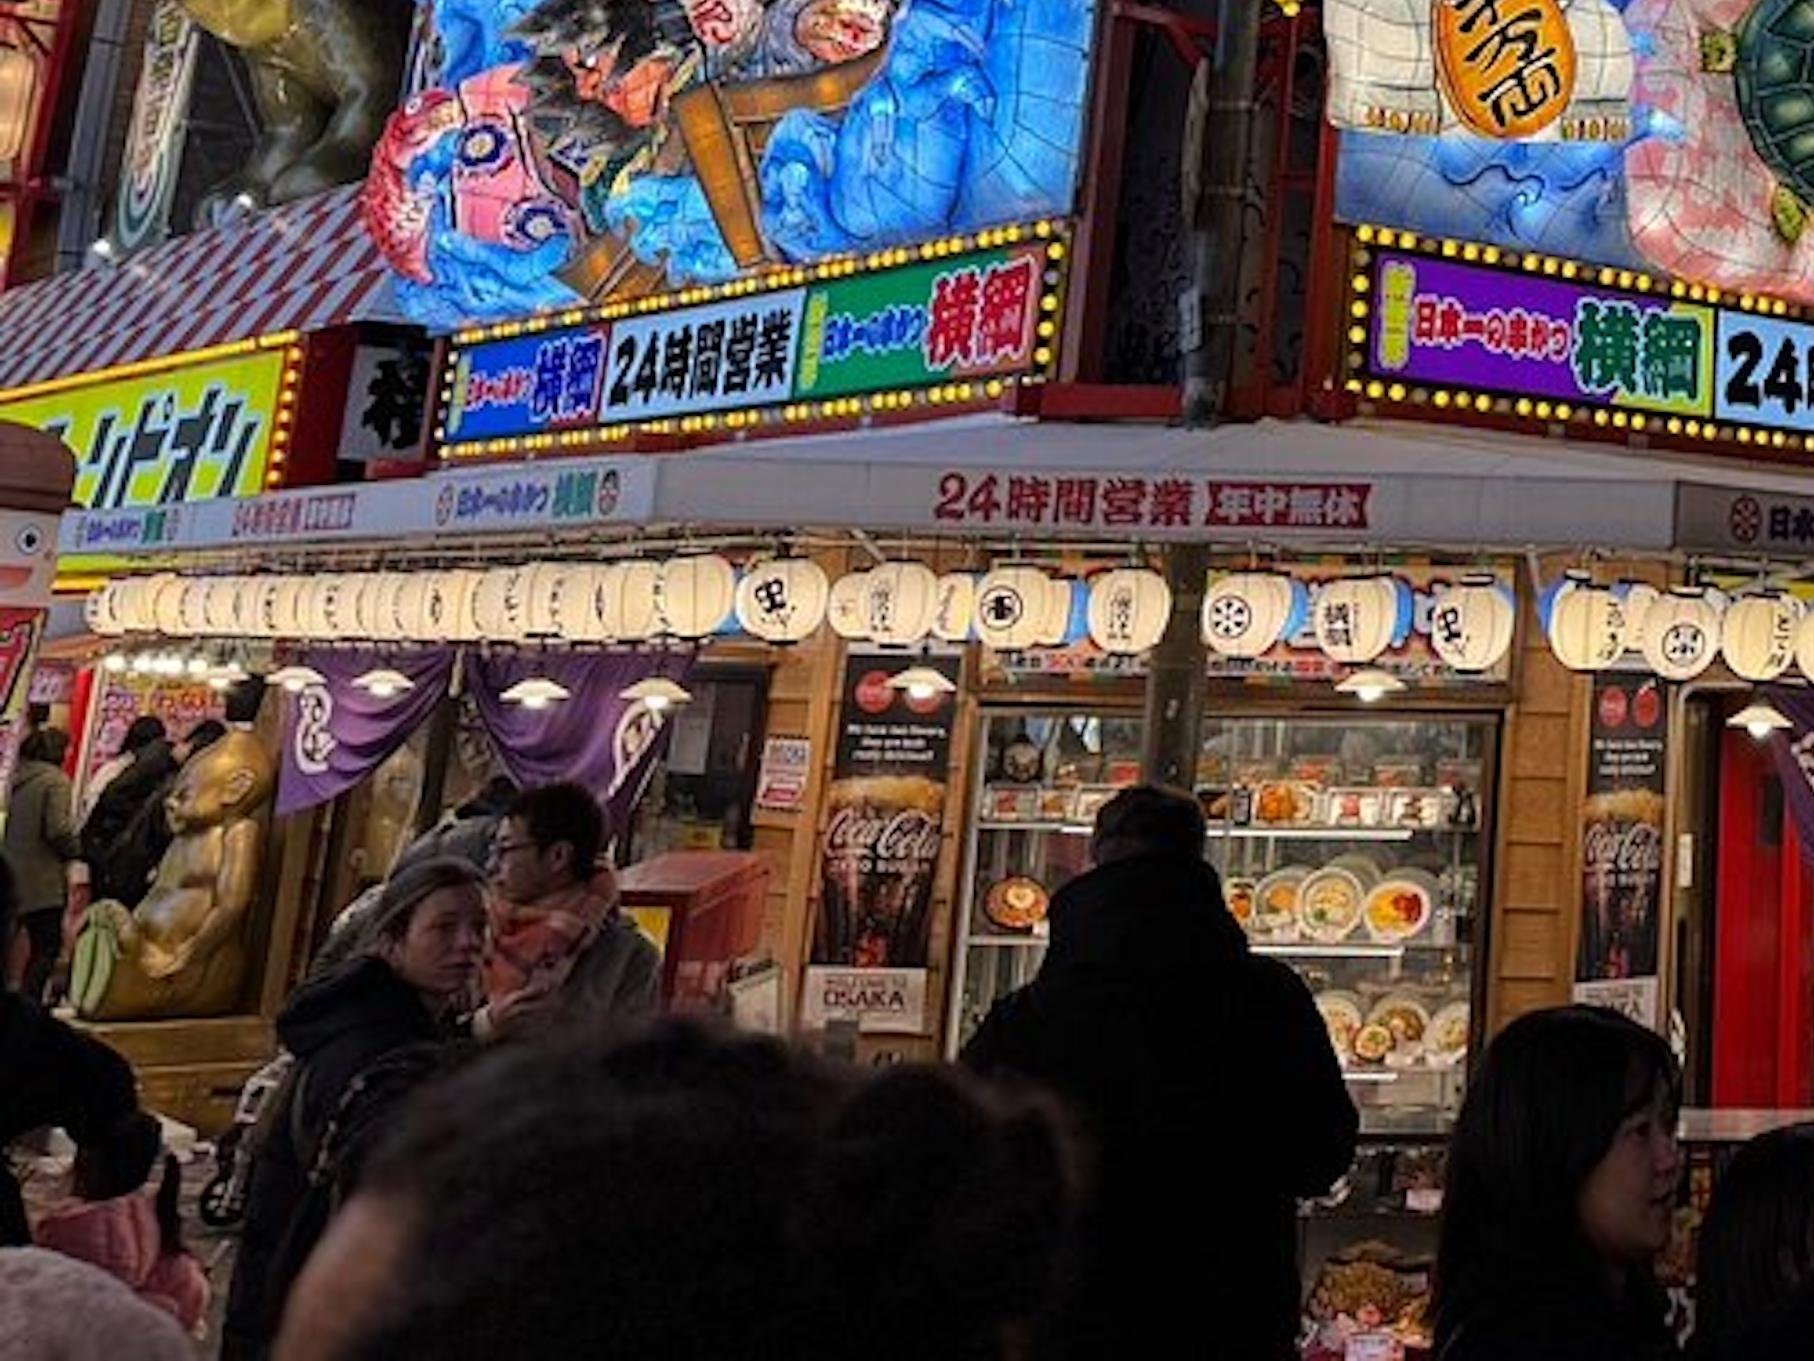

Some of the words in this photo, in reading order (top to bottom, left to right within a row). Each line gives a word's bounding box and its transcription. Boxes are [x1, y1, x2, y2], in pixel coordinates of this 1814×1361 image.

[608, 308, 794, 408] 24時間営業
[926, 258, 1037, 366] 横綱
[1416, 302, 1569, 356] 日本一の串かつ
[1574, 301, 1700, 401] 横綱
[934, 472, 1194, 526] 24時間営業
[1212, 484, 1364, 526] 年中無休
[822, 988, 905, 1009] OSAKA
